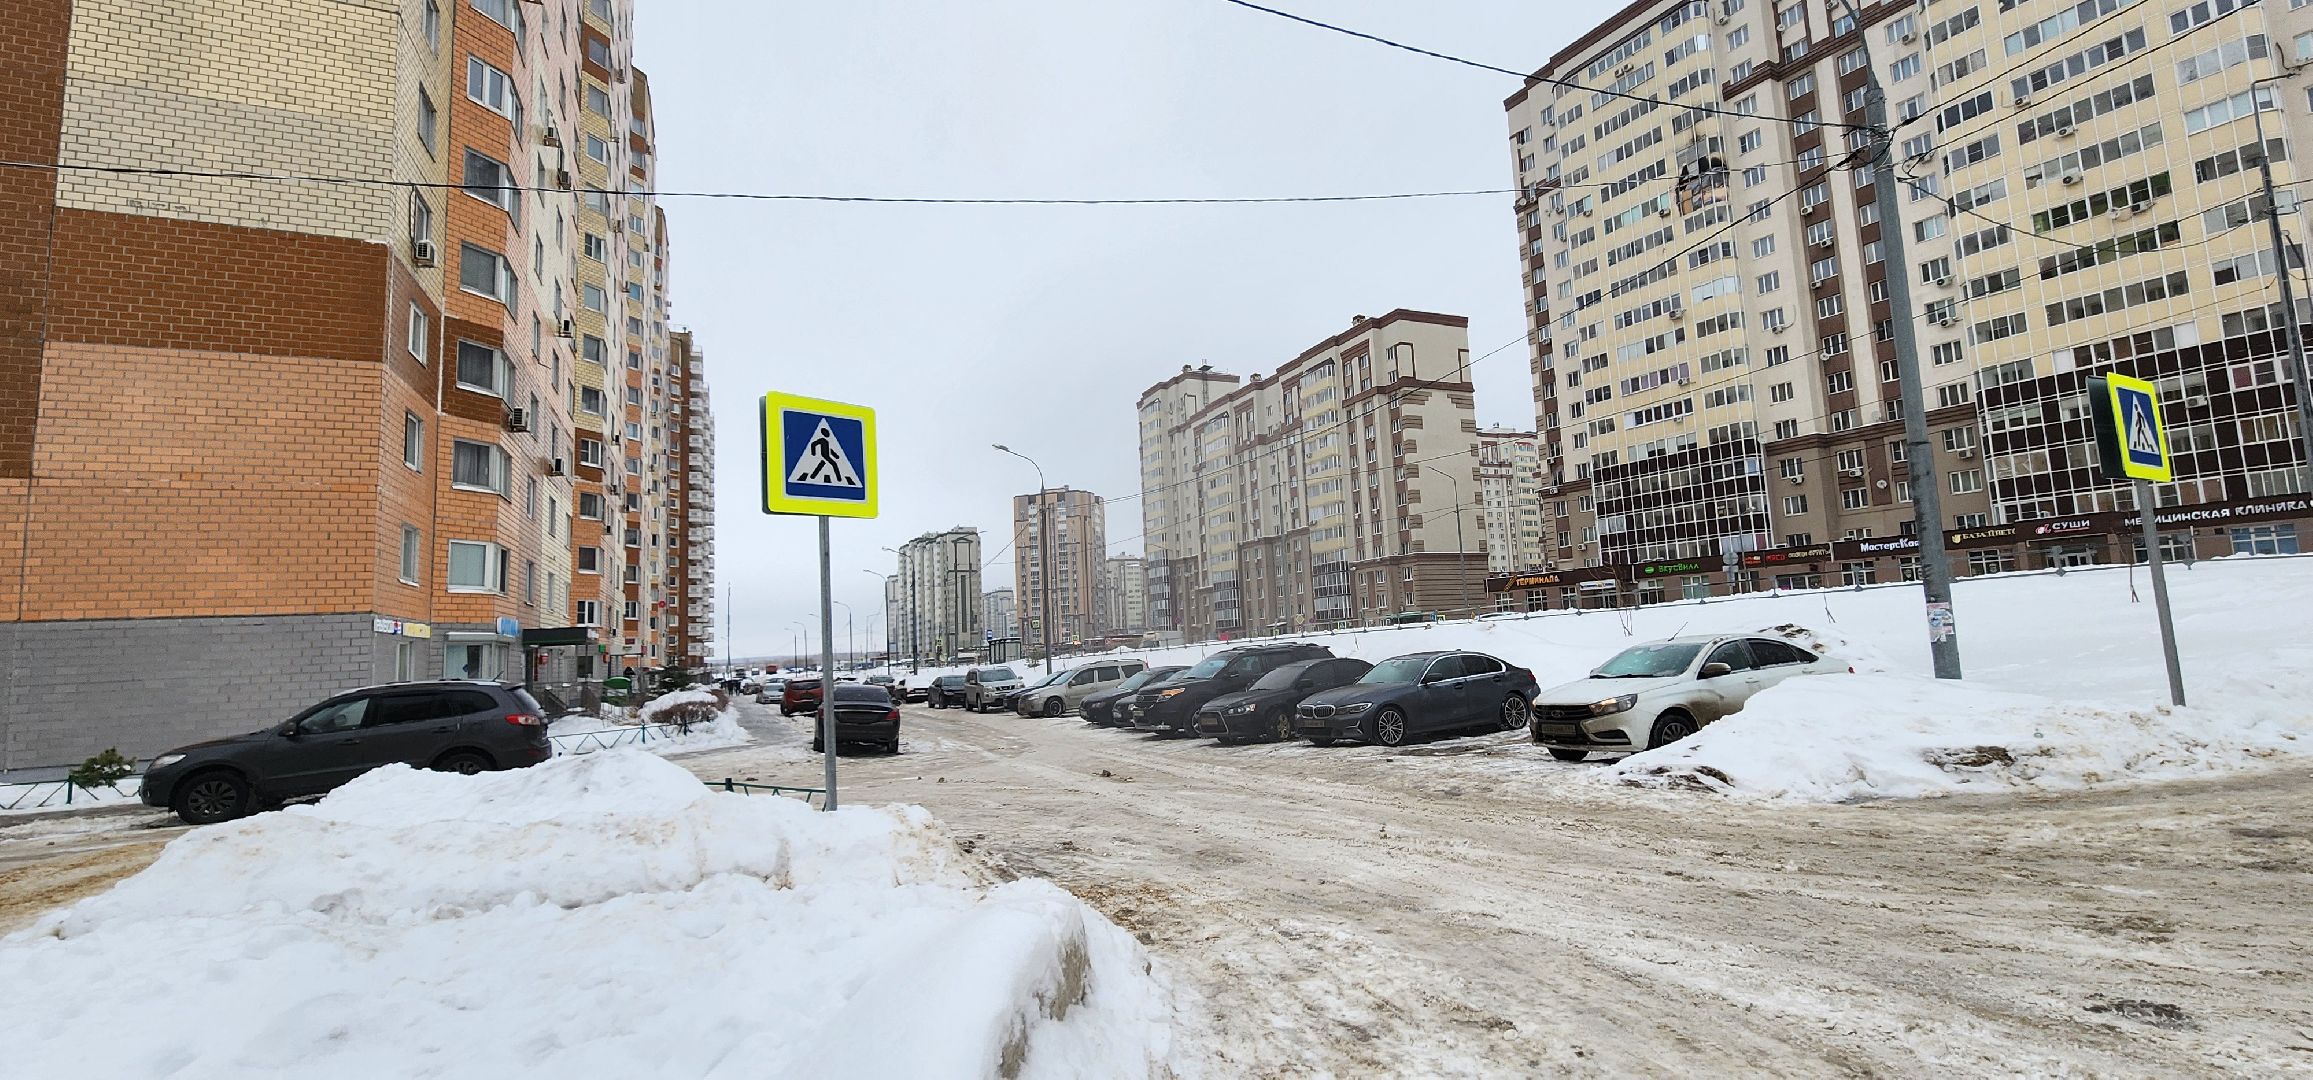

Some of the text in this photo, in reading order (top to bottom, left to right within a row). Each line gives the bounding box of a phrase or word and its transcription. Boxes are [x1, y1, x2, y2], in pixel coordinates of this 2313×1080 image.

[2124, 500, 2307, 527] МЕИЦИНСКАЯ КЛИНИКА
[2052, 519, 2090, 530] СУШИ
[1962, 532, 1986, 540] БАЗА
